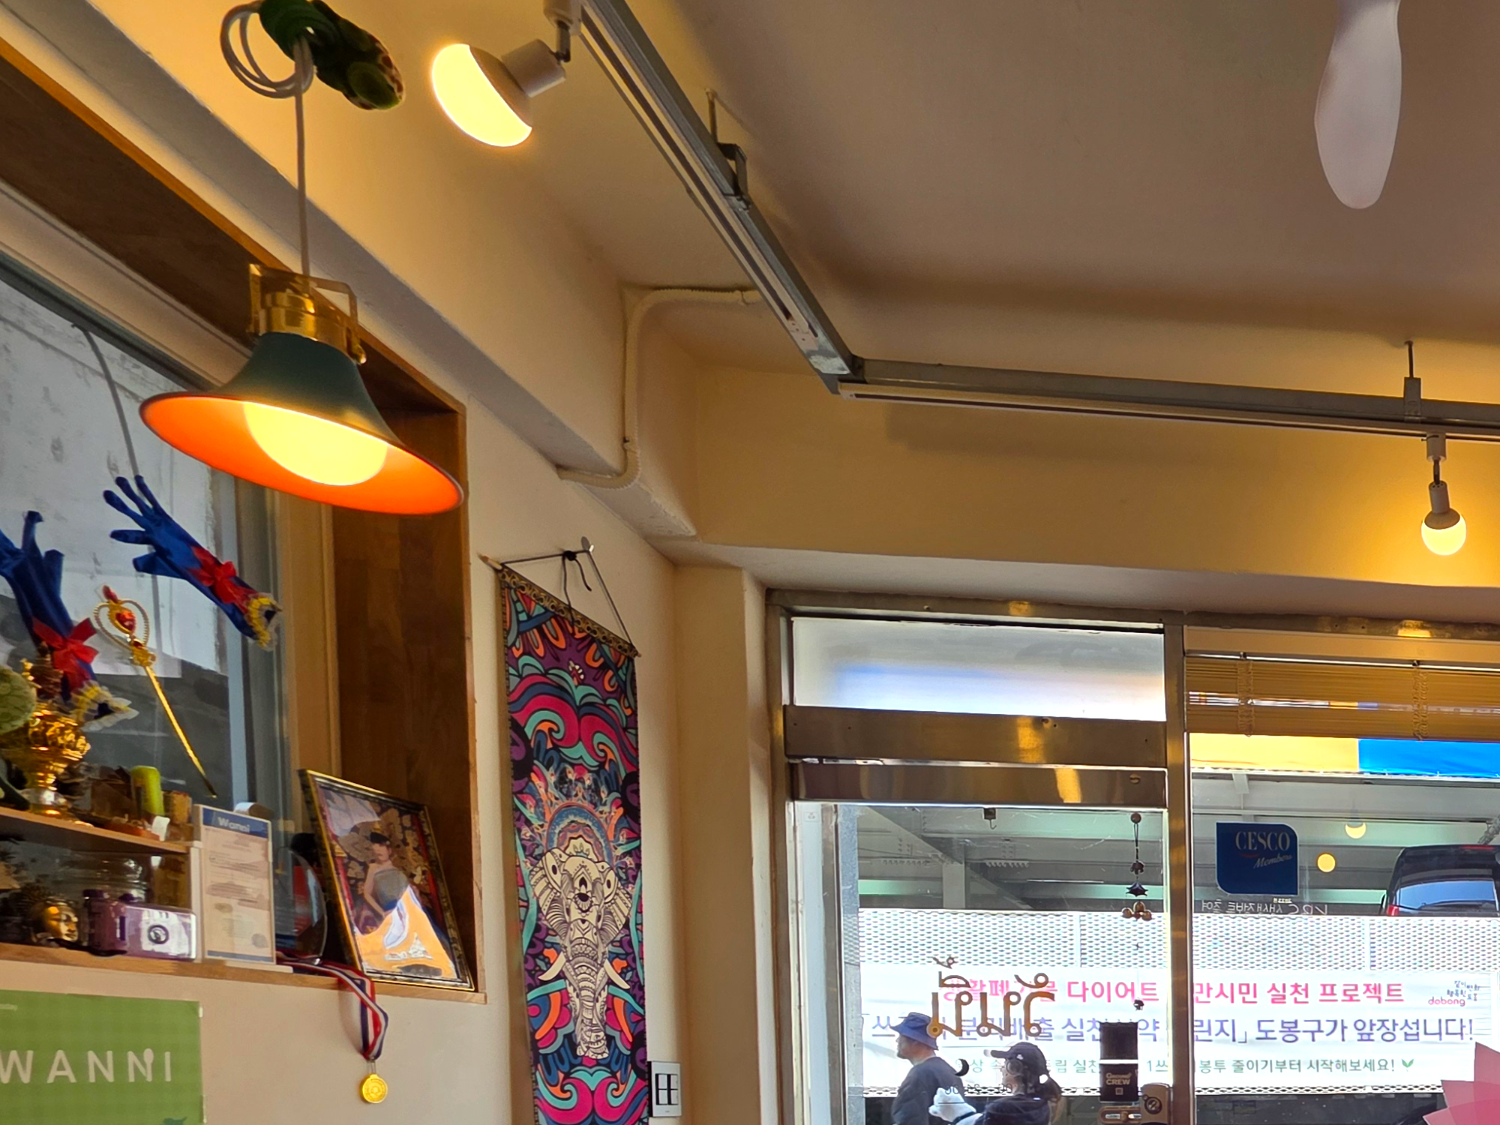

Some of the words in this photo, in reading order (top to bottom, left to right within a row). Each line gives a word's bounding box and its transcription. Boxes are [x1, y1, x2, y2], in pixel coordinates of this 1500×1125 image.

[1235, 830, 1291, 851] CESCO
[1067, 980, 1160, 1003] 다이어트
[1266, 982, 1310, 1004] 실천
[1318, 982, 1405, 1003] 프로젝트
[1428, 996, 1466, 1007] dobong
[1256, 1019, 1348, 1043] 도봉구가
[1354, 1018, 1474, 1042] 앞장섭니다!
[0, 1048, 172, 1084] WANNI
[1199, 1059, 1228, 1073] 봉투
[1231, 1059, 1303, 1073] 줄이기부터
[1306, 1059, 1396, 1073] 시작해보세요!
